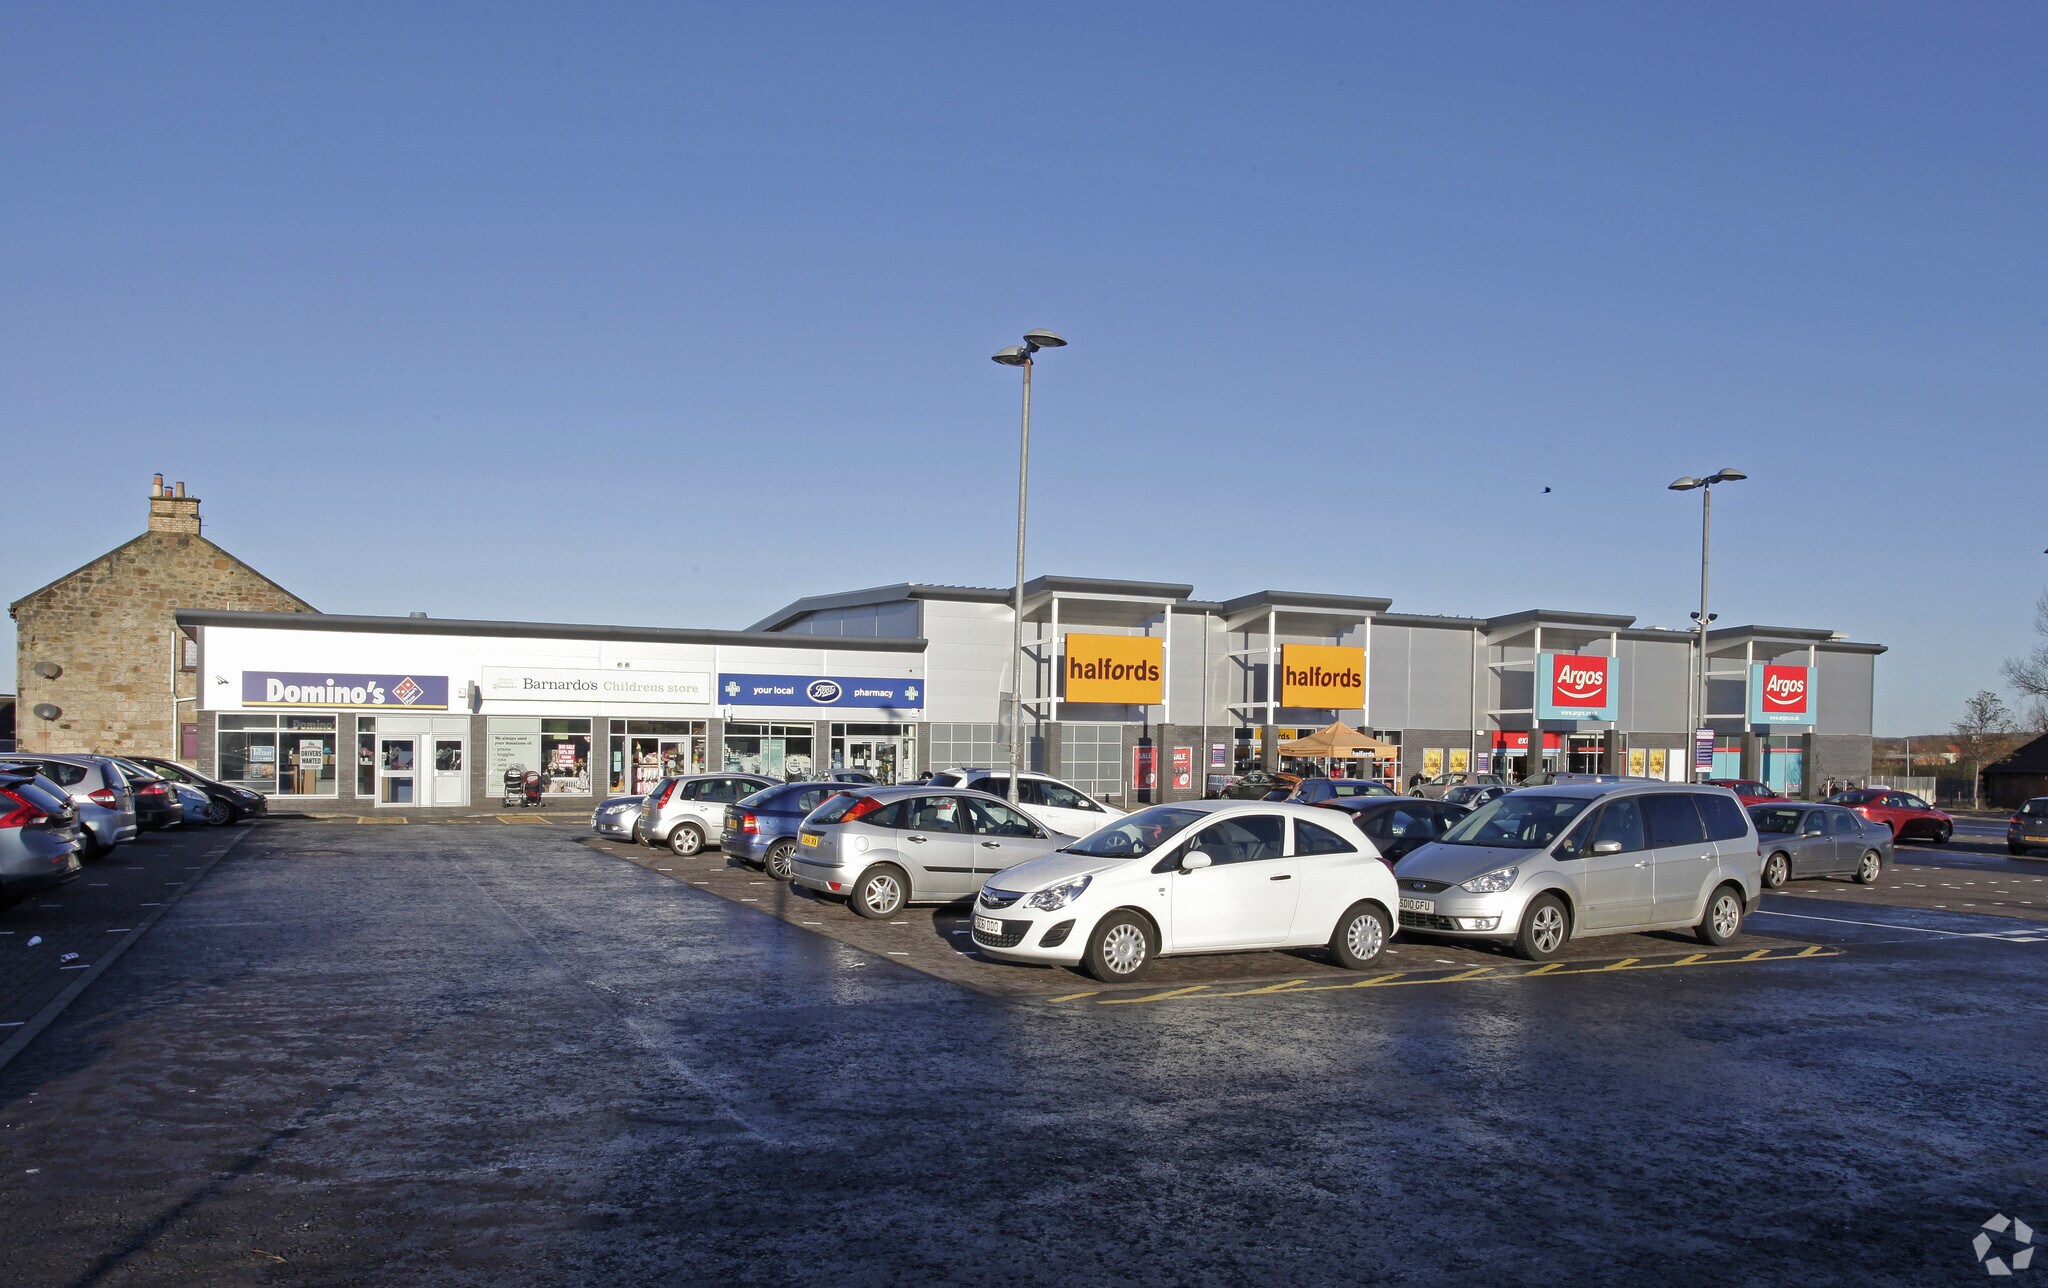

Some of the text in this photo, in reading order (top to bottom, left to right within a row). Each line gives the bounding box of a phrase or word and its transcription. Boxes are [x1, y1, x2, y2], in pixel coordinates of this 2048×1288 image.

[1070, 656, 1160, 682] halfords
[1285, 665, 1362, 688] halfords
[1557, 664, 1604, 690] Argos
[266, 678, 386, 704] Domino's
[523, 678, 699, 694] Barnardo's Childrens store
[753, 685, 794, 696] your local
[812, 684, 837, 699] Boots
[854, 688, 894, 699] pharmacy
[1766, 674, 1805, 698] Argos
[301, 757, 321, 765] WANTED
[1137, 752, 1153, 760] SALE
[1352, 750, 1376, 758] halfords
[1400, 898, 1430, 911] SD10 GFU
